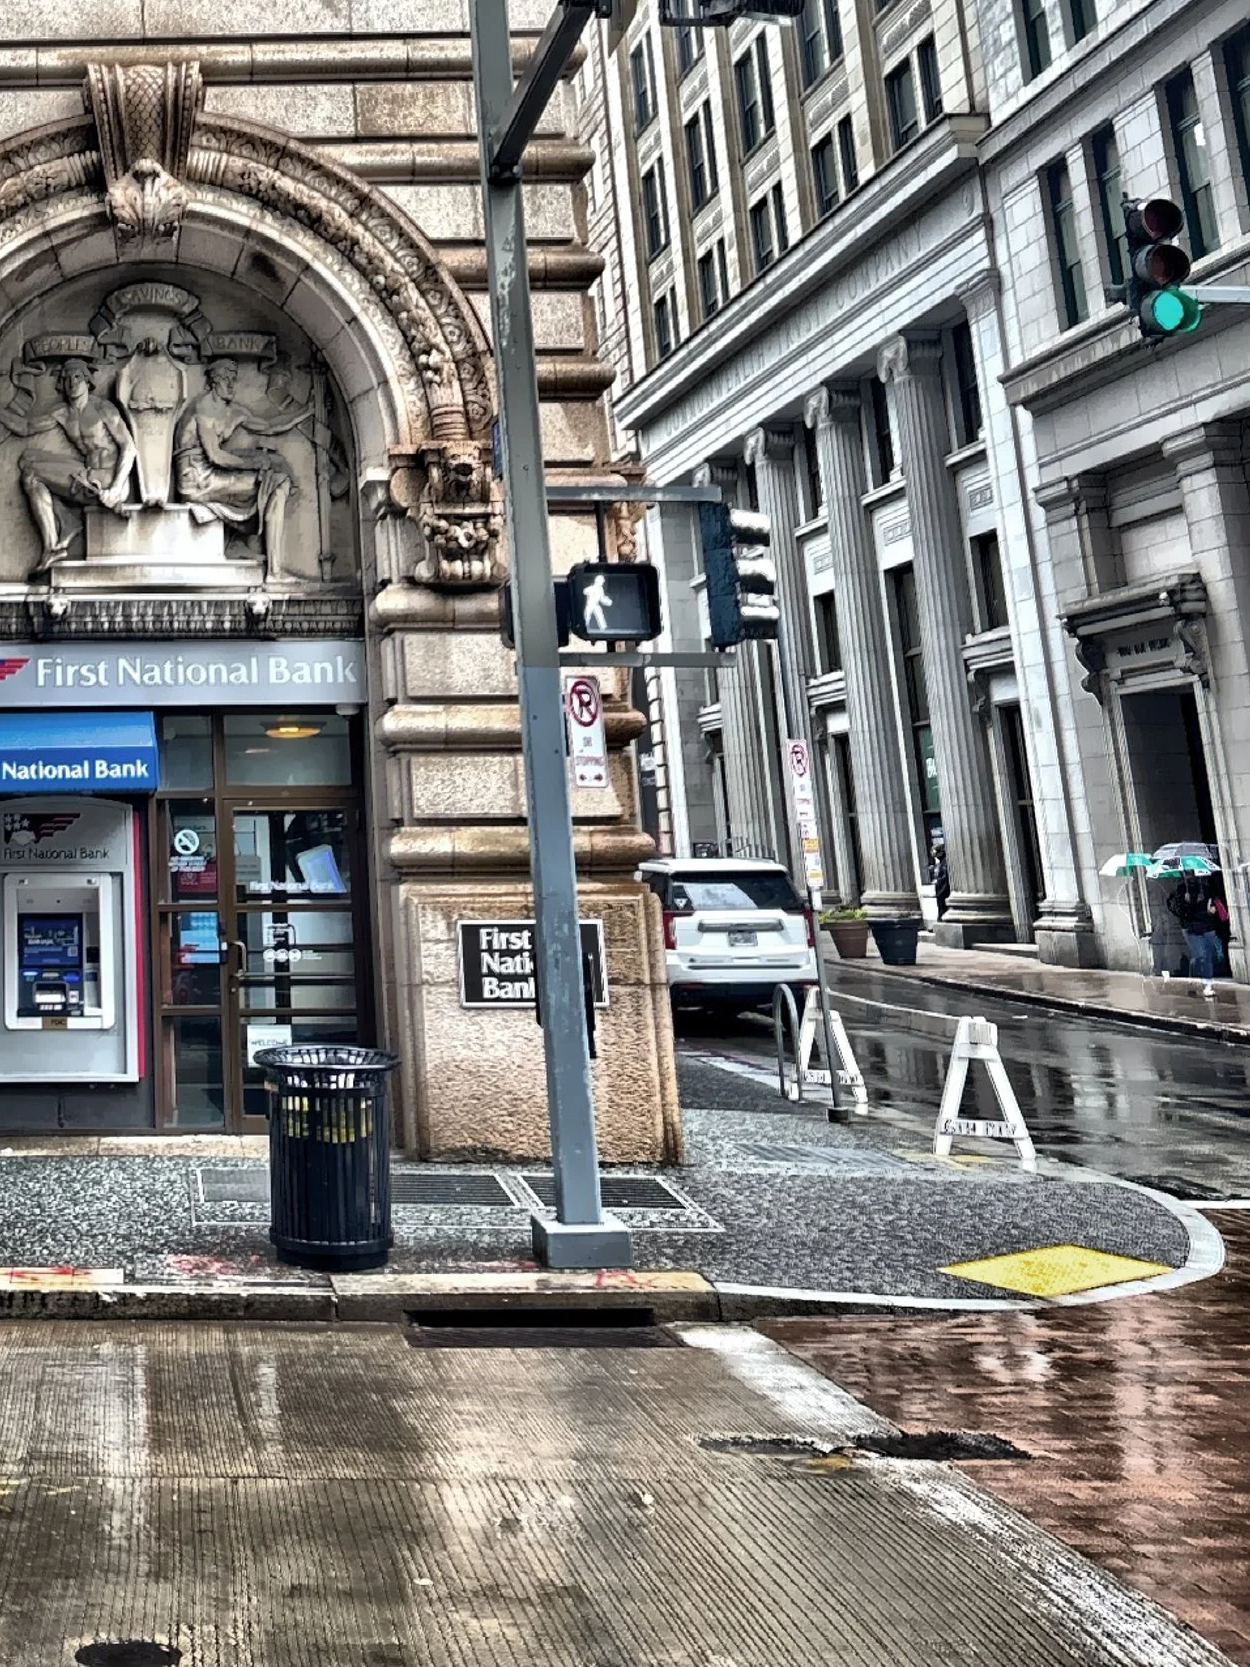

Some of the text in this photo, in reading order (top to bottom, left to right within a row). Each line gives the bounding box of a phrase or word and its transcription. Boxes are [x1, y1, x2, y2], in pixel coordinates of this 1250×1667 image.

[835, 218, 922, 311] COMPANY
[120, 286, 183, 305] SAVINGS
[216, 336, 260, 350] BANK
[36, 655, 357, 687] First National Bank
[1, 760, 90, 780] National
[94, 759, 149, 780] Bank
[3, 847, 109, 859] First National Bank
[480, 927, 532, 950] First
[481, 952, 534, 974] Nati
